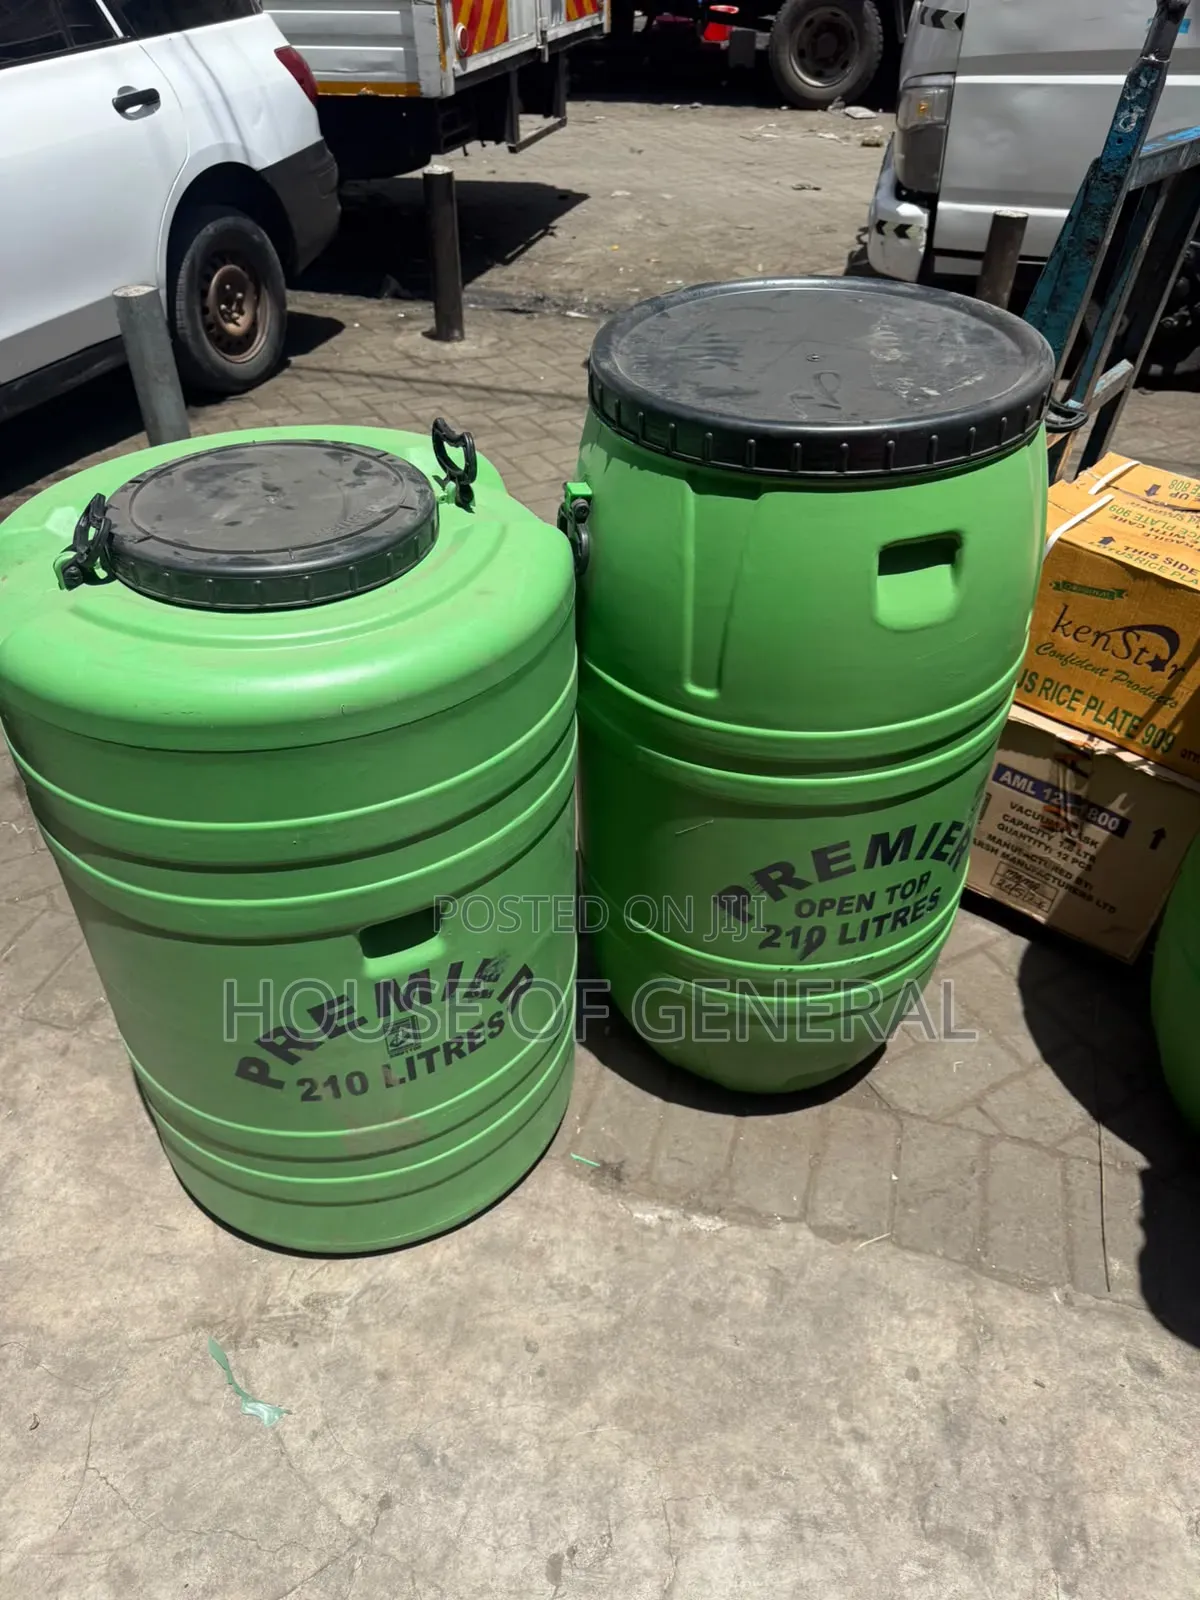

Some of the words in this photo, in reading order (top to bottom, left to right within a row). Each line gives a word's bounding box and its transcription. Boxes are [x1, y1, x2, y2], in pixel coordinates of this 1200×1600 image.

[1108, 504, 1132, 517] 909
[1169, 492, 1190, 501] UP
[1134, 514, 1177, 531] PLATE
[1123, 545, 1160, 560] THIS
[1163, 556, 1200, 577] SIDE
[1035, 642, 1109, 678] Confident
[1110, 669, 1179, 710] Products
[1036, 677, 1084, 713] RICE
[1082, 698, 1143, 740] PLATE
[1142, 723, 1177, 753] 909
[1000, 770, 1037, 795] AML
[1069, 855, 1094, 873] PCS
[794, 891, 876, 919] OPEN
[885, 870, 932, 905] TOP
[758, 923, 827, 958] 210
[838, 886, 942, 947] LITRES
[234, 955, 535, 1091] PREMIER
[296, 1069, 370, 1103] 210
[381, 1010, 506, 1090] LITRES
